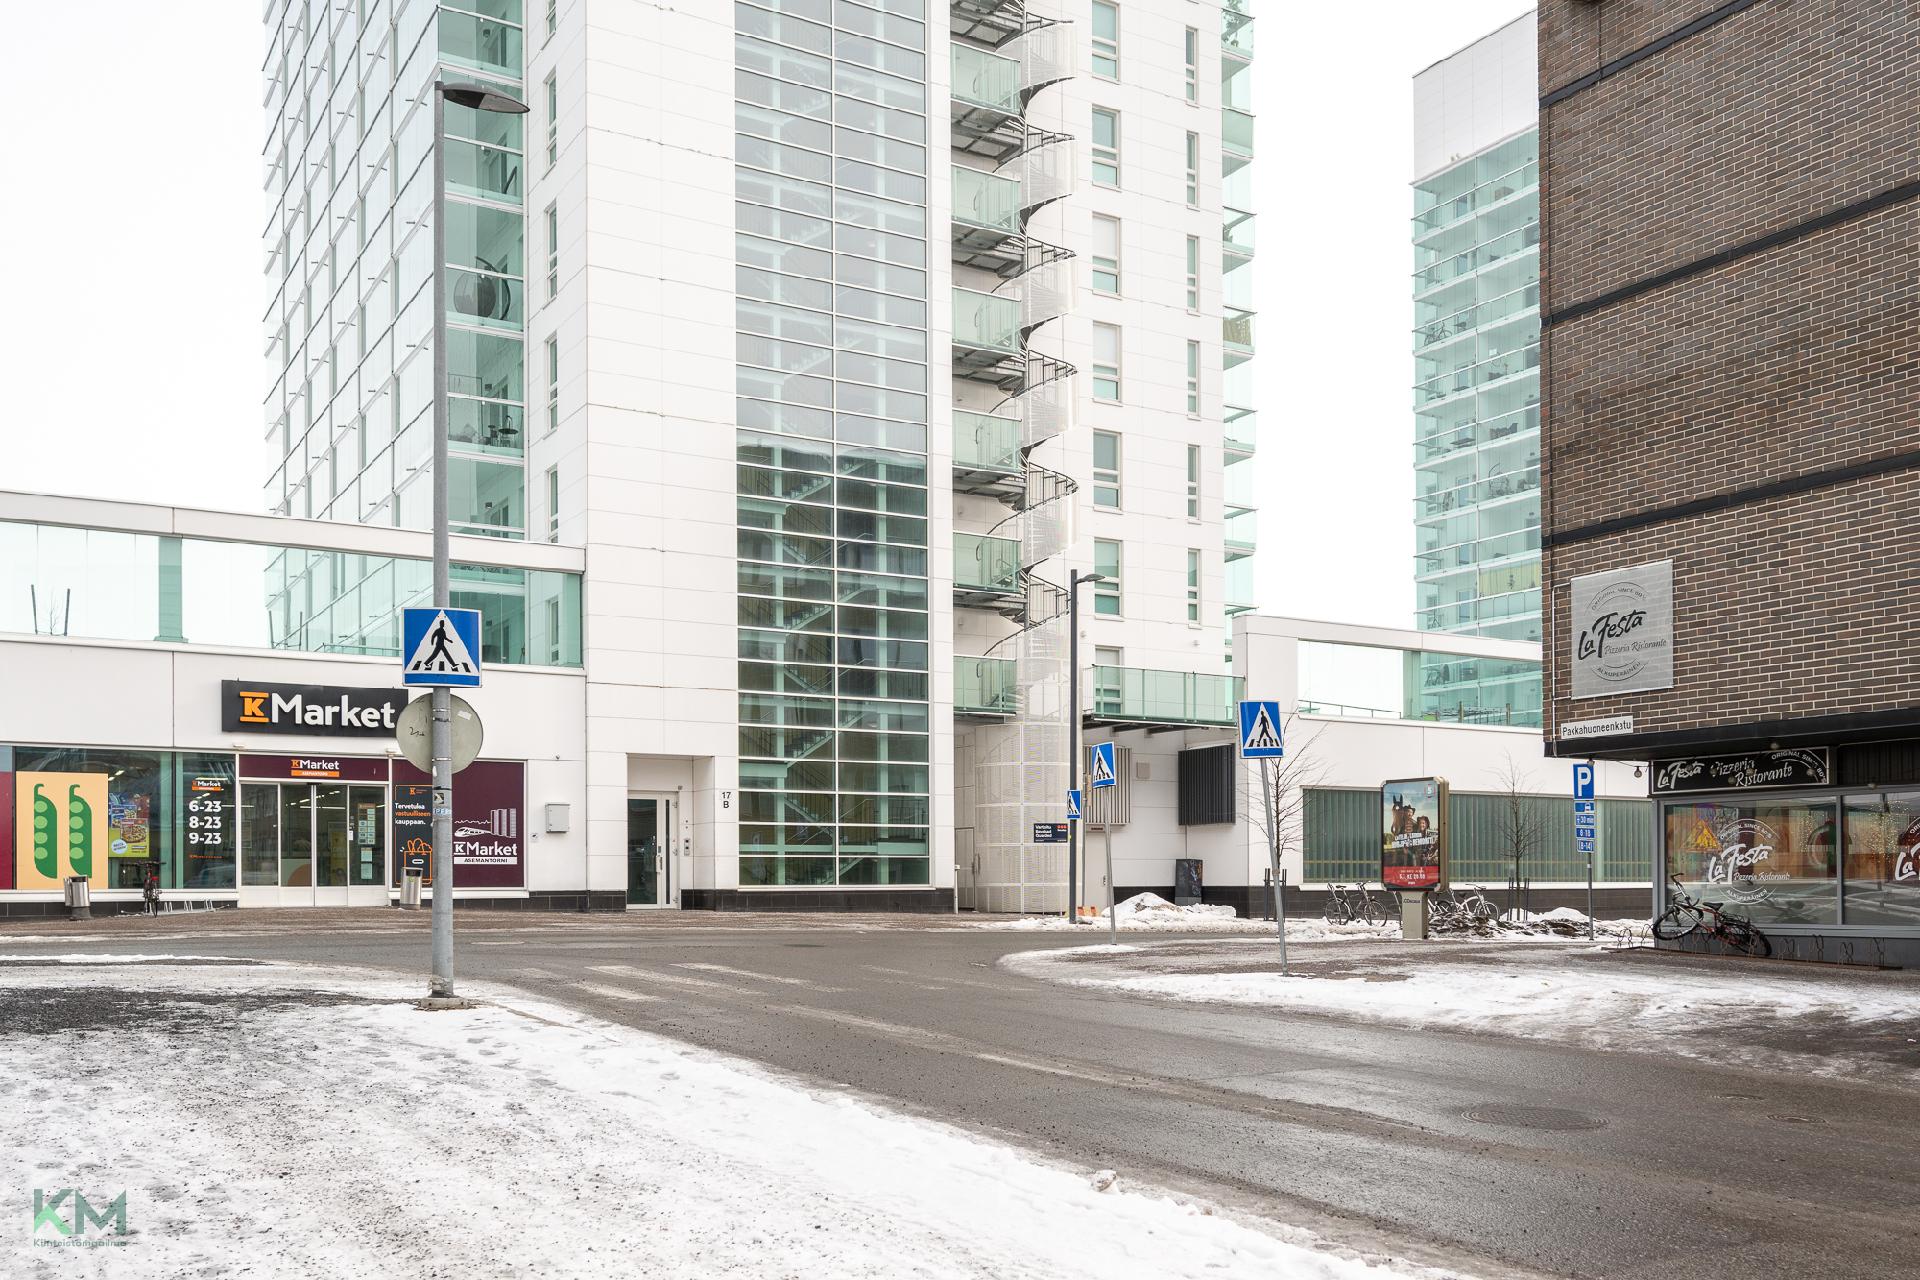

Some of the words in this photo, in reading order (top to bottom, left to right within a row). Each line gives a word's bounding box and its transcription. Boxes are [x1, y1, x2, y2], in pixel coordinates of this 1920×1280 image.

[1578, 631, 1596, 660] La
[1592, 609, 1647, 658] Festa
[1604, 644, 1630, 656] Pizzeria
[1631, 638, 1667, 652] Ristorante
[271, 693, 396, 729] Market
[1562, 717, 1632, 737] Pakkahuoneenkatu
[299, 759, 340, 770] Market
[1577, 766, 1592, 797] P
[1657, 769, 1670, 789] La
[1668, 761, 1705, 789] Festa
[1735, 762, 1793, 787] Ristorante
[722, 791, 731, 799] 17
[189, 800, 222, 813] 6-23
[723, 800, 730, 809] B
[189, 816, 222, 829] 8-23
[395, 818, 426, 827] kauppaan.
[1744, 823, 1761, 831] SINCE
[189, 832, 222, 845] 9-23
[466, 841, 518, 856] Market
[1708, 856, 1726, 883] La
[1721, 844, 1773, 884] Festa
[1894, 851, 1917, 881] La
